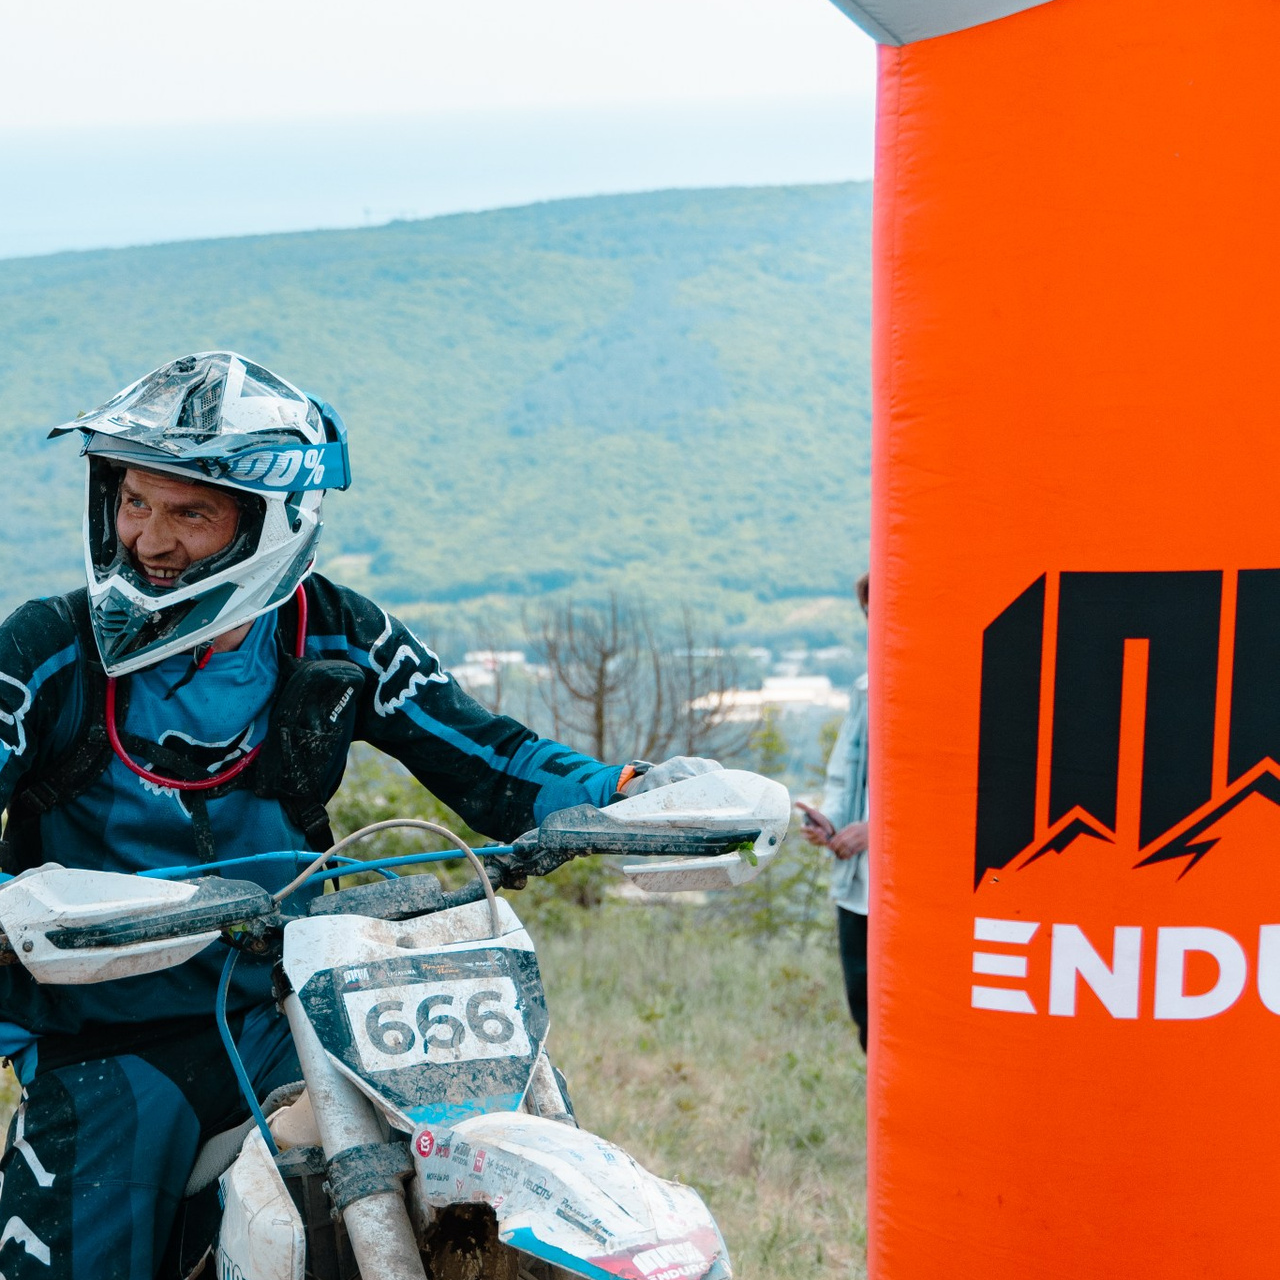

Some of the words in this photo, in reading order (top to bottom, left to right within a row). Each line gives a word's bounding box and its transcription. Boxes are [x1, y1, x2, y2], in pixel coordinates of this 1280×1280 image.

[227, 449, 325, 487] 00%
[329, 686, 355, 723] USWE
[970, 916, 1280, 1020] END
[364, 989, 516, 1056] 666
[523, 1178, 553, 1201] VELOCITY
